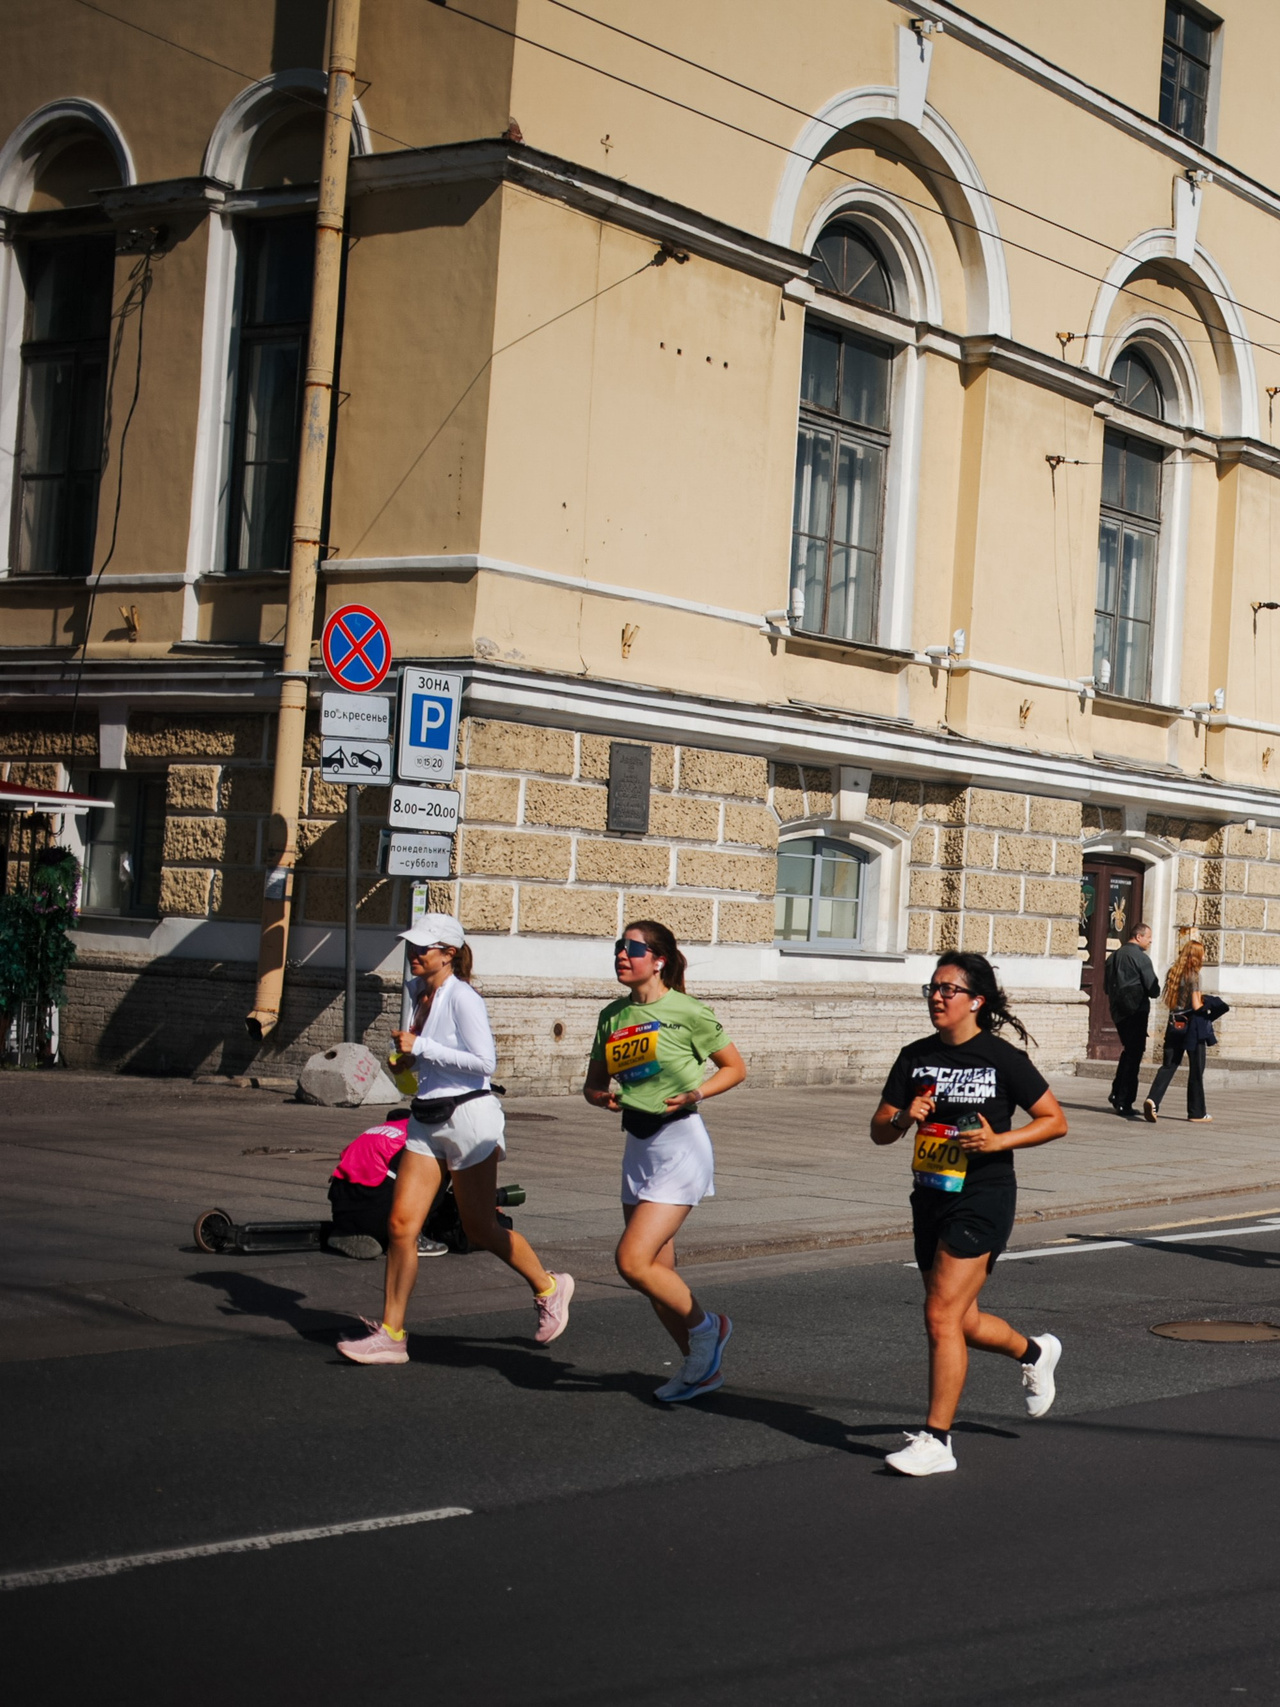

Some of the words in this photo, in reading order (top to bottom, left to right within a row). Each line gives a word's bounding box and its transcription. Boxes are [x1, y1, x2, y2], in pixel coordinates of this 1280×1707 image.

[418, 676, 450, 692] ЗОНА
[423, 758, 431, 766] 15
[432, 758, 443, 768] 20
[399, 858, 439, 869] -суббота
[612, 1037, 650, 1062] 5270
[935, 1082, 997, 1098] РОССИИ
[917, 1141, 960, 1165] 6470
